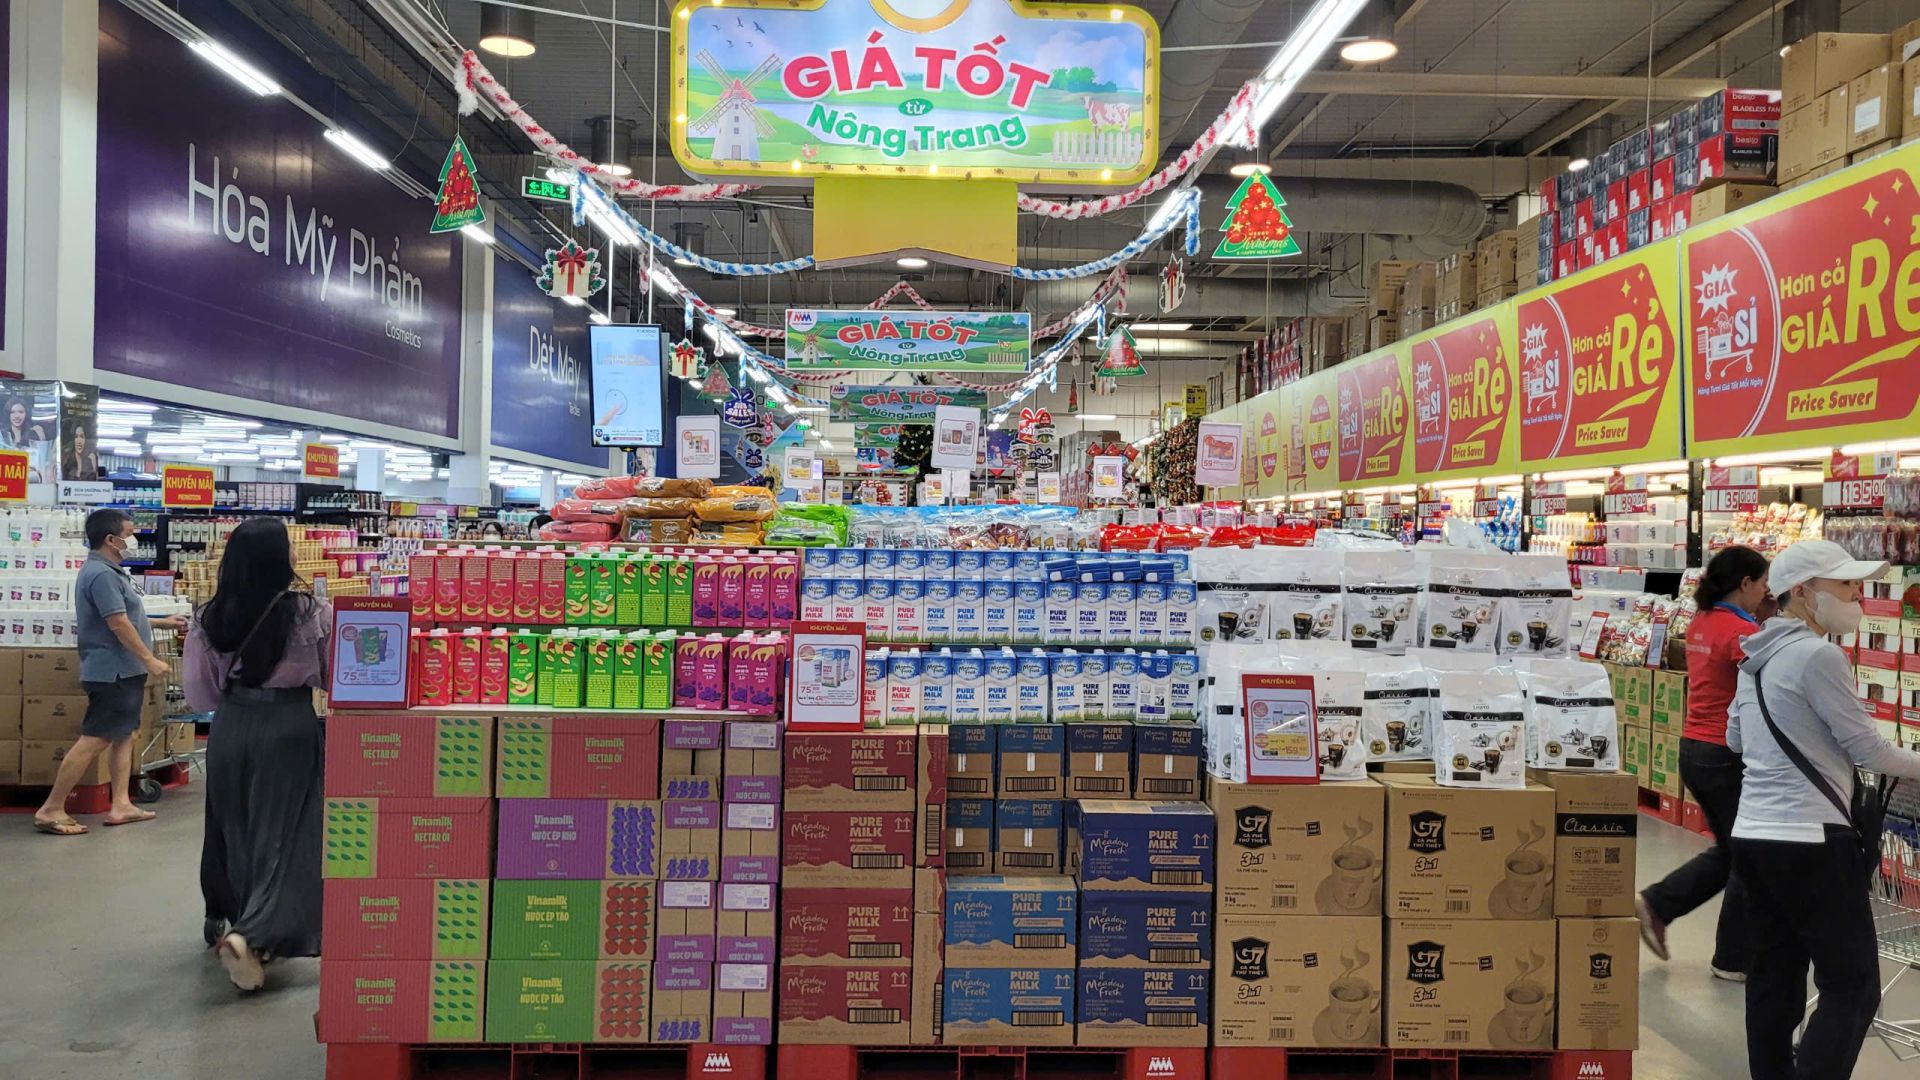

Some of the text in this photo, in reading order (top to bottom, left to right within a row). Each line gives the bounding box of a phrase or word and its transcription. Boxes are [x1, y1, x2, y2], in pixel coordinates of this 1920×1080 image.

[783, 30, 1051, 108] GIÁ TỐT
[905, 100, 927, 115] từ
[806, 103, 1027, 158] Nông Trang
[188, 142, 423, 319] Hóa Mỹ Phẩm
[1779, 257, 1845, 300] Hơn cả
[838, 316, 978, 346] GIÁ TỐT
[1781, 295, 1839, 353] GIÁ
[385, 320, 422, 349] Cosmetics
[1572, 336, 1593, 354] Hơn
[1609, 298, 1663, 391] Rẻ
[530, 325, 581, 400] Dệt May
[850, 344, 966, 366] Nông Trang
[1472, 346, 1505, 418] Rẻ
[1573, 353, 1608, 396] GIÁ
[863, 389, 953, 407] GIÁ TỐT
[1450, 388, 1471, 421] GIÁ
[1790, 387, 1873, 413] Price Saver
[1577, 425, 1626, 442] Price Saver
[1452, 446, 1466, 458] Price
[5, 464, 25, 479] MÃI
[166, 474, 213, 490] KHUYẾN MÃI
[1868, 622, 1881, 631] TEA
[1860, 671, 1870, 680] TEA
[1904, 678, 1915, 686] TEA
[361, 733, 401, 744] Vinamilk
[585, 737, 624, 747] Vinamilk
[851, 739, 884, 749] PURE
[792, 743, 831, 759] Meadow
[806, 752, 830, 763] Fresh
[851, 750, 884, 759] MILK
[412, 816, 452, 827] Vinamilk
[534, 815, 574, 825] Vinamilk
[1238, 816, 1268, 832] G7
[1564, 817, 1626, 833] Classic
[561, 831, 576, 841] NHO
[1148, 830, 1178, 839] PURE
[1413, 820, 1442, 837] G7
[1090, 837, 1128, 852] Meadow
[1103, 845, 1127, 856] Fresh
[1148, 839, 1178, 849] MILK
[1240, 852, 1265, 867] 3in1
[1415, 856, 1438, 871] 3in1
[527, 895, 567, 906] Vinamilk
[1012, 893, 1042, 902] PURE
[848, 906, 880, 917] PURE
[953, 900, 992, 916] Meadow
[967, 908, 990, 919] Fresh
[1012, 902, 1042, 912] MILK
[848, 917, 880, 927] MILK
[1235, 947, 1265, 964] G7
[1411, 950, 1441, 967] G7
[355, 978, 396, 989] Vinamilk
[1144, 971, 1173, 981] PURE
[1086, 978, 1124, 994] Meadow
[1100, 986, 1122, 998] Fresh
[1144, 980, 1173, 990] MILK
[1238, 983, 1262, 999] 3in1
[1413, 987, 1437, 1001] 3in1
